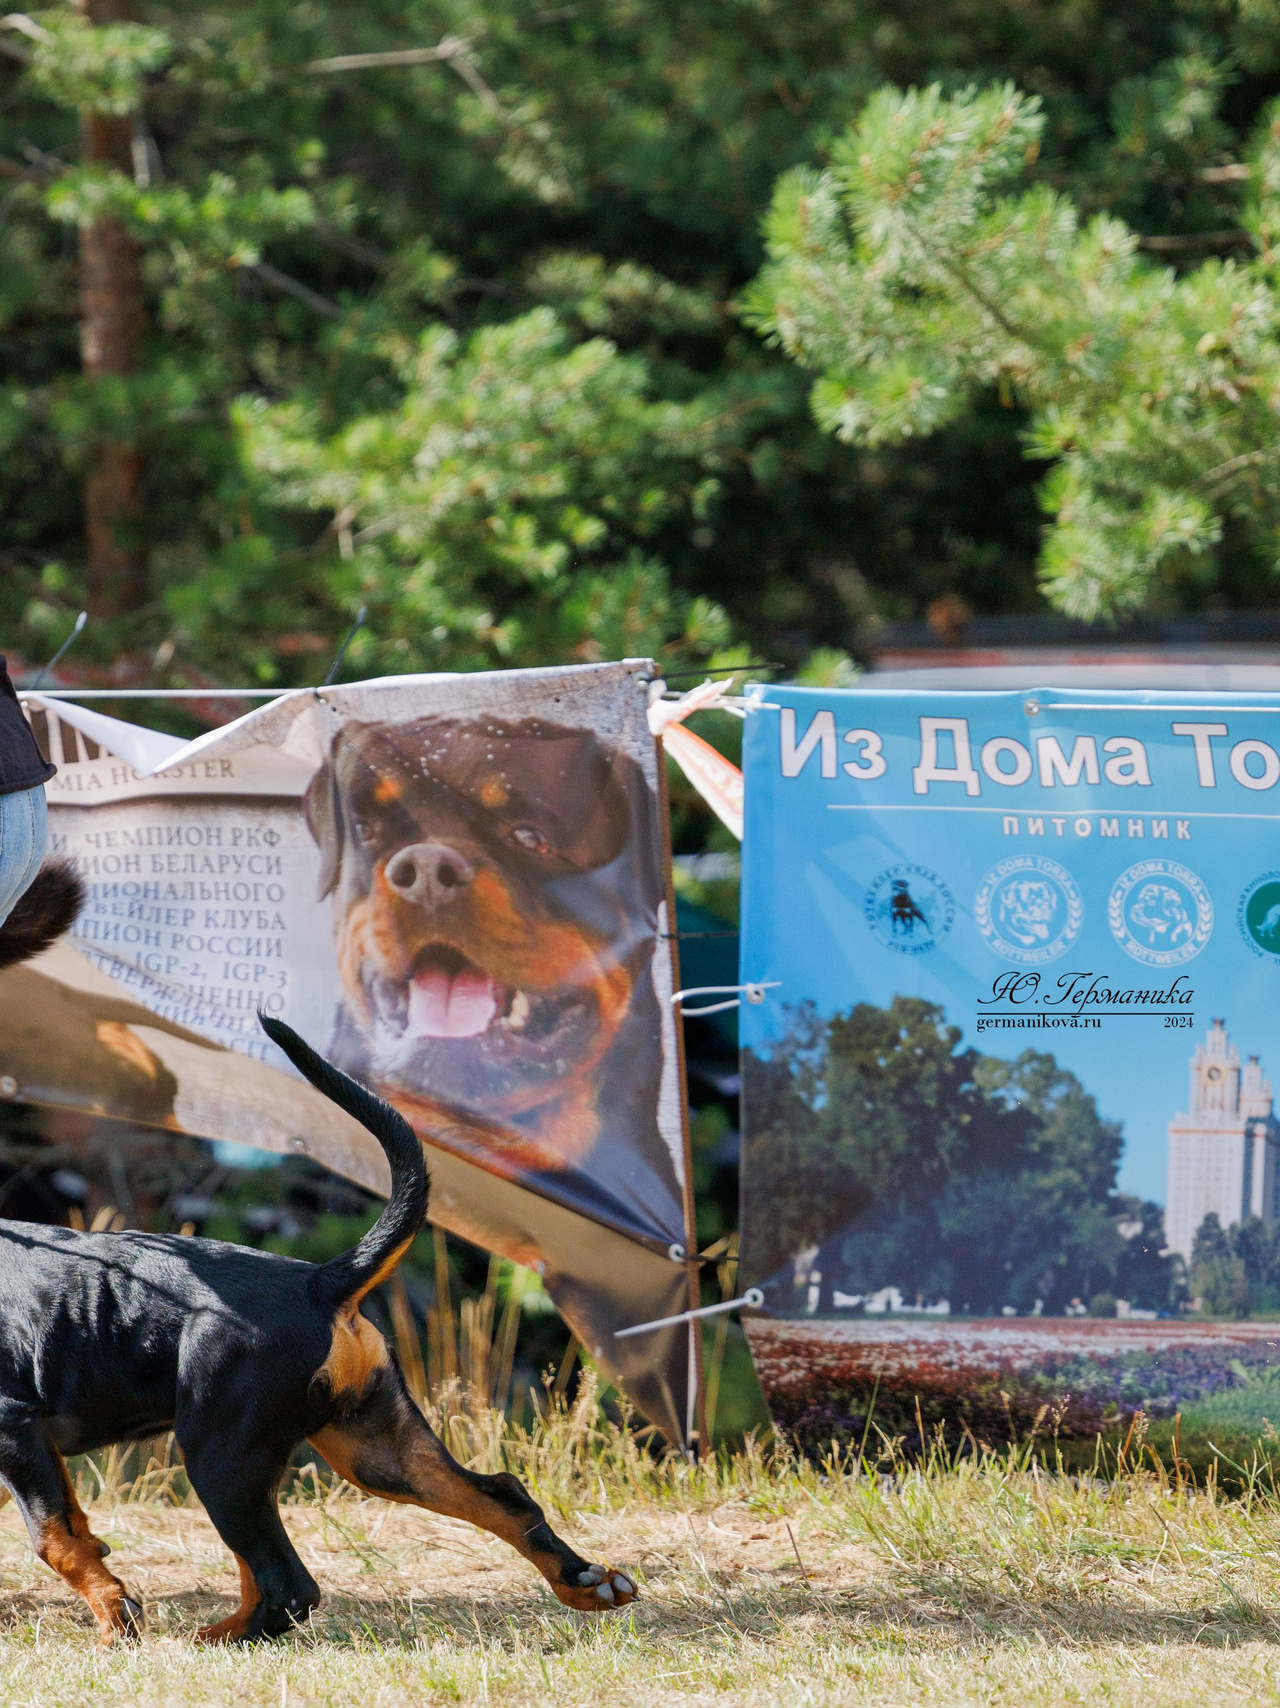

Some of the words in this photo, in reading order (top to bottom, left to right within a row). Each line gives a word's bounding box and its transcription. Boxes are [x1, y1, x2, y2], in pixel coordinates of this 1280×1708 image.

[780, 706, 888, 781] Из
[911, 716, 1154, 797] Дома
[1171, 721, 1280, 791] То
[51, 772, 104, 791] MIA
[84, 826, 221, 849] ЧЕМПИОН
[231, 826, 282, 848] РКФ
[1002, 815, 1192, 841] ПИТОМНИК
[80, 853, 142, 876] ИОН
[150, 854, 283, 876] БЕЛАРУСИ
[92, 898, 196, 928] ВЕЙЛЕР
[203, 908, 287, 931] КЛУБА
[171, 932, 284, 958] РОССИИ
[222, 961, 289, 989] IGP-3
